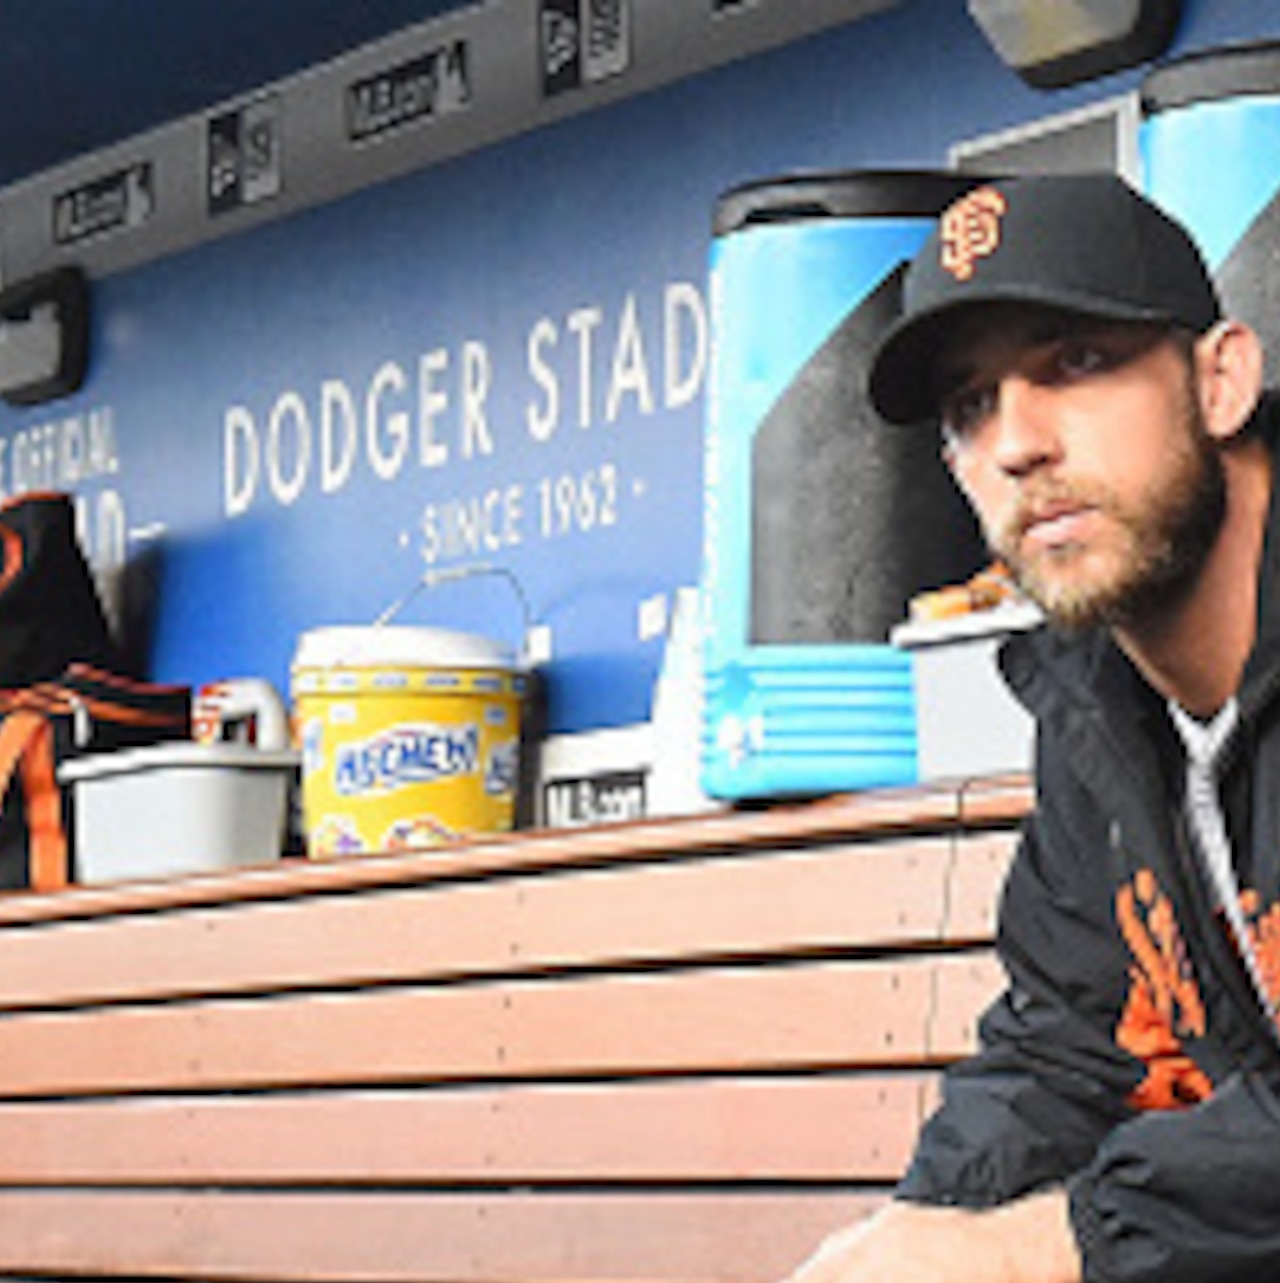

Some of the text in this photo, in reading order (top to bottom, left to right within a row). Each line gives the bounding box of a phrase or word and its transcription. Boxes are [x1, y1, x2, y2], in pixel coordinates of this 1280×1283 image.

[224, 281, 709, 519] DODGER STAD
[421, 462, 620, 565] SINCE 1962
